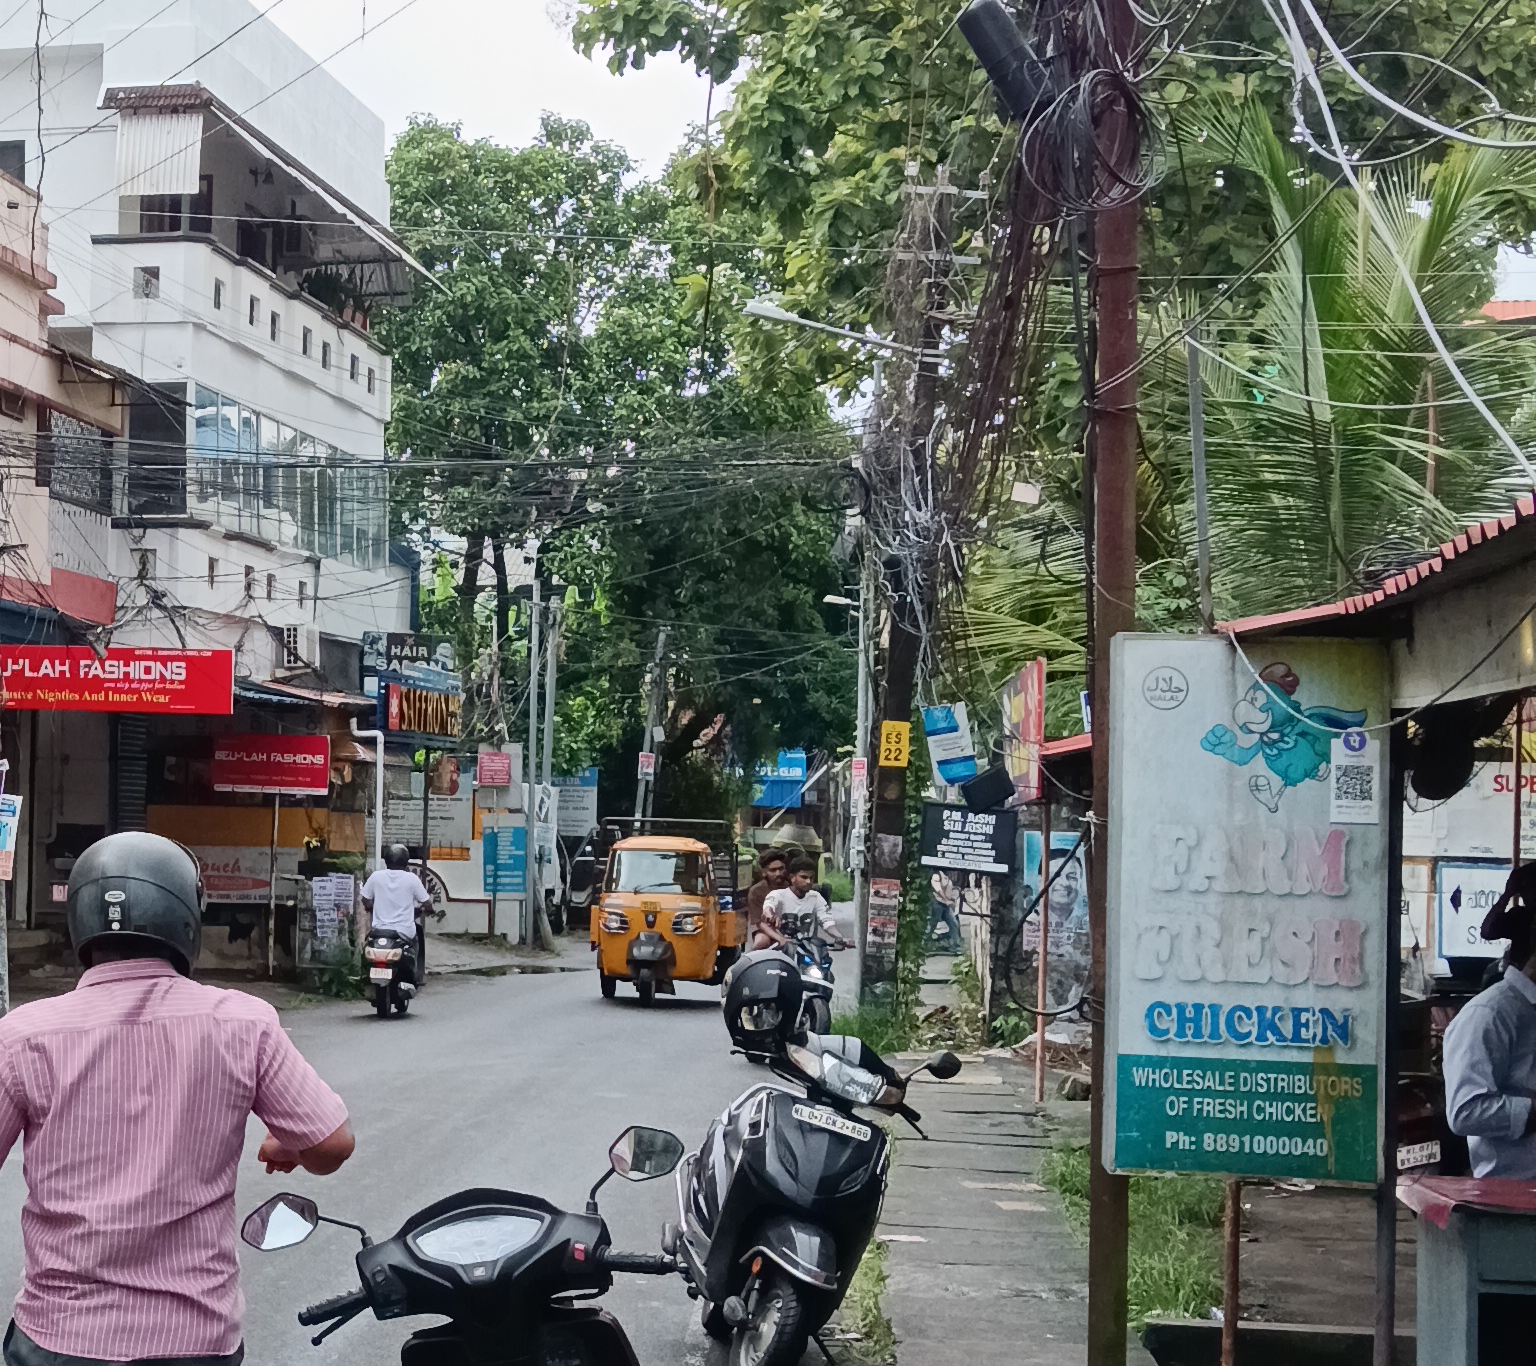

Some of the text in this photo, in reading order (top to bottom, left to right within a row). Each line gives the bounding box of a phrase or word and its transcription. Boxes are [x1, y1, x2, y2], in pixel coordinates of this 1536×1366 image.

[390, 644, 428, 658] HAIR
[79, 659, 187, 681] FASHIONS
[82, 689, 105, 702] And
[108, 690, 138, 703] Inner
[141, 691, 171, 703] Wear
[1146, 675, 1185, 694] حلال
[270, 752, 325, 765] FASHIONS
[883, 747, 903, 762] 22
[1151, 824, 1351, 897] FARM
[1134, 915, 1367, 987] FRESH
[1144, 1000, 1353, 1049] CHICKEN
[1132, 1066, 1363, 1098] WHOLESALE DISTRIBUTORS
[1165, 1096, 1332, 1123] OF FRESH CHICKEN
[1165, 1130, 1328, 1157] Ph: 8891000040
